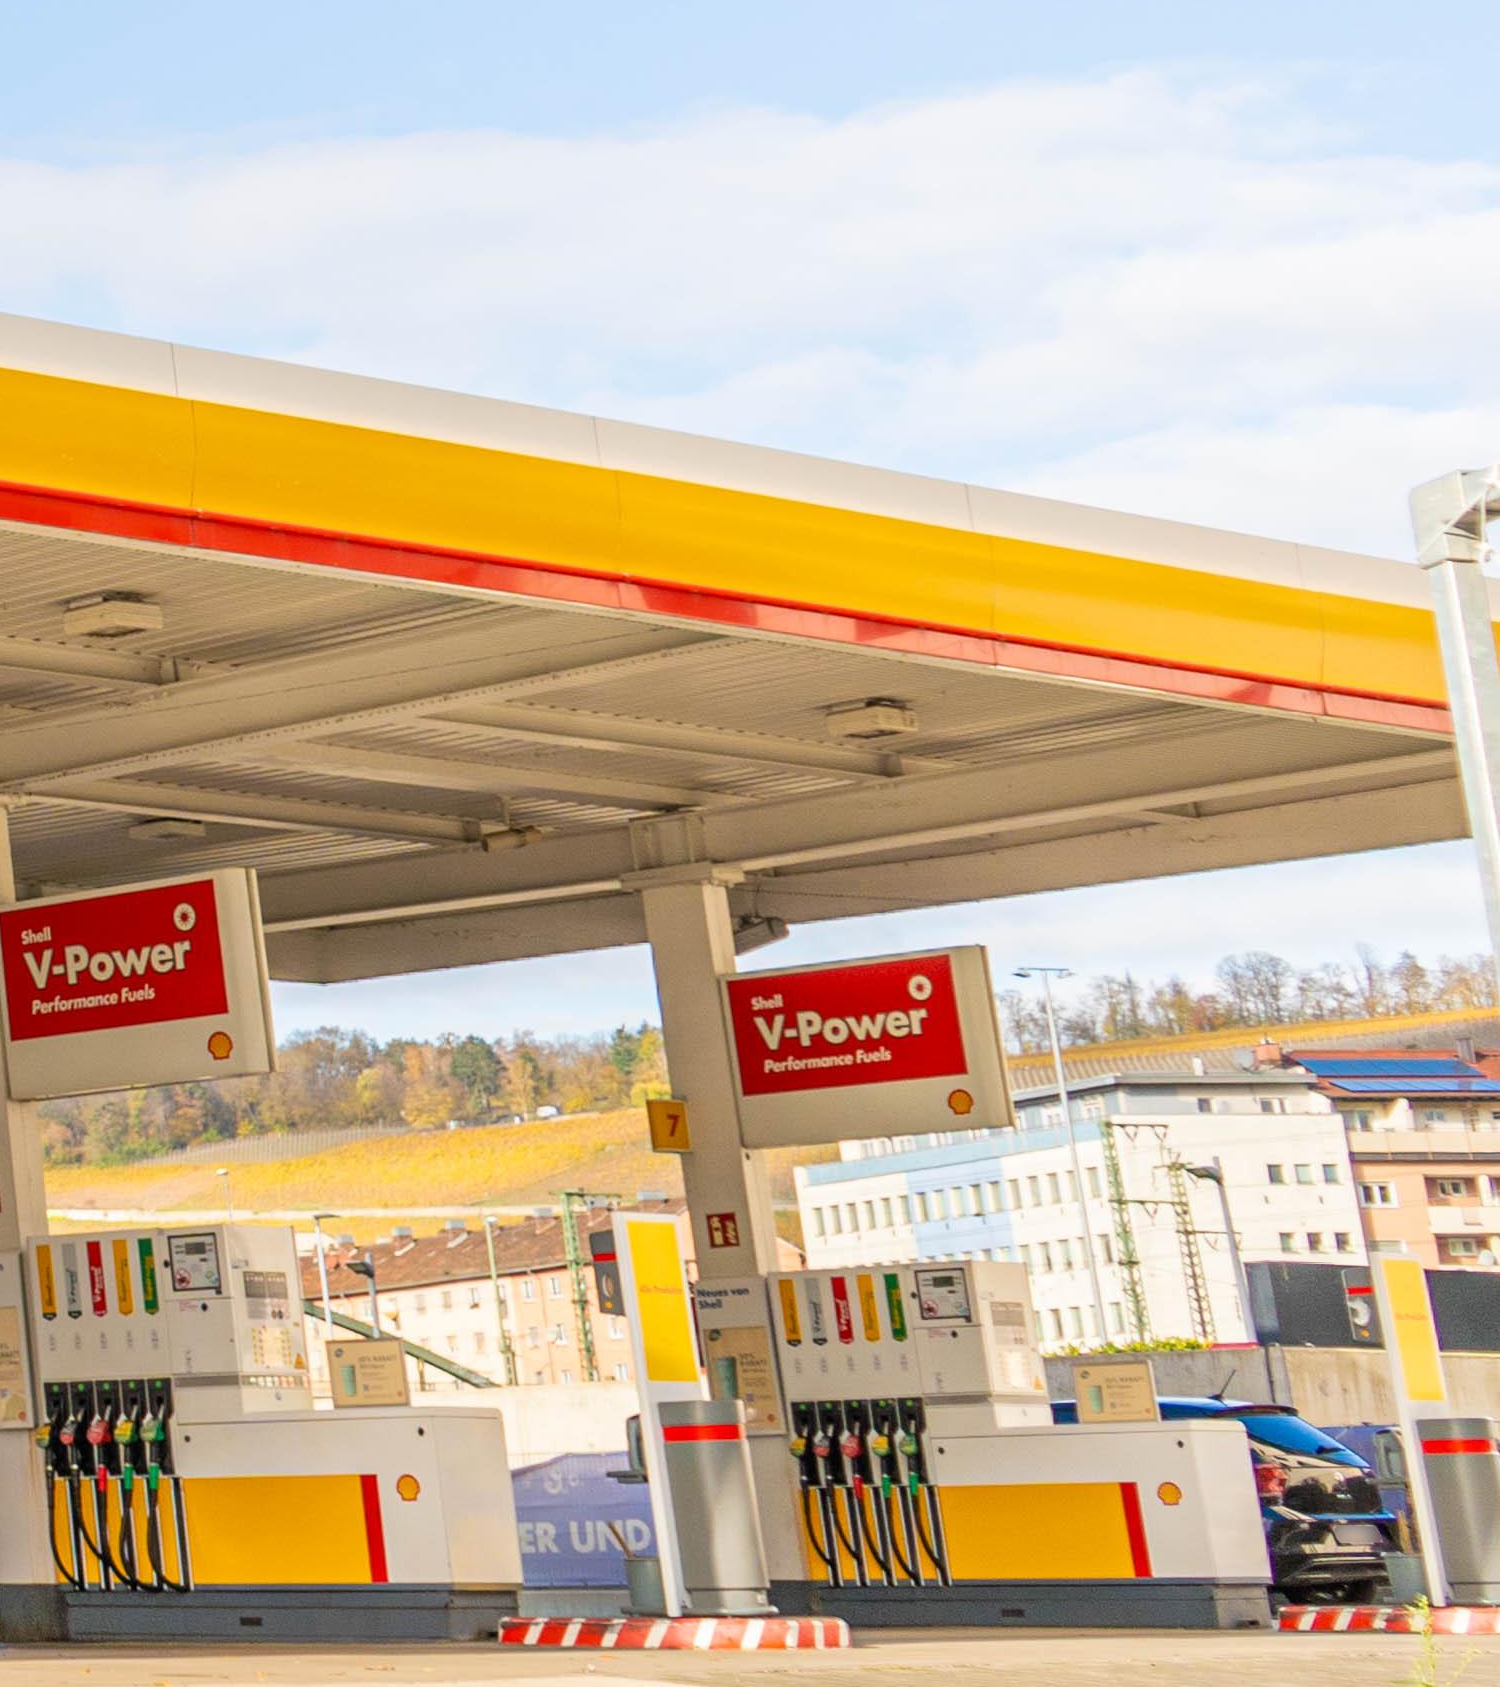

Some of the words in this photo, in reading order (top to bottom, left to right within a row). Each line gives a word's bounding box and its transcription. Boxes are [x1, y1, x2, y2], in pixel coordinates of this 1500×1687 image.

[21, 926, 52, 945] Shell
[23, 940, 192, 989] V-Power
[32, 992, 118, 1015] Performance
[121, 983, 155, 1003] Fuels
[751, 994, 783, 1010] Shell
[753, 1008, 929, 1051] V-Power
[764, 1053, 853, 1073] Performance
[856, 1046, 892, 1064] Fuels
[665, 1114, 679, 1139] 7
[569, 1519, 651, 1554] UND
